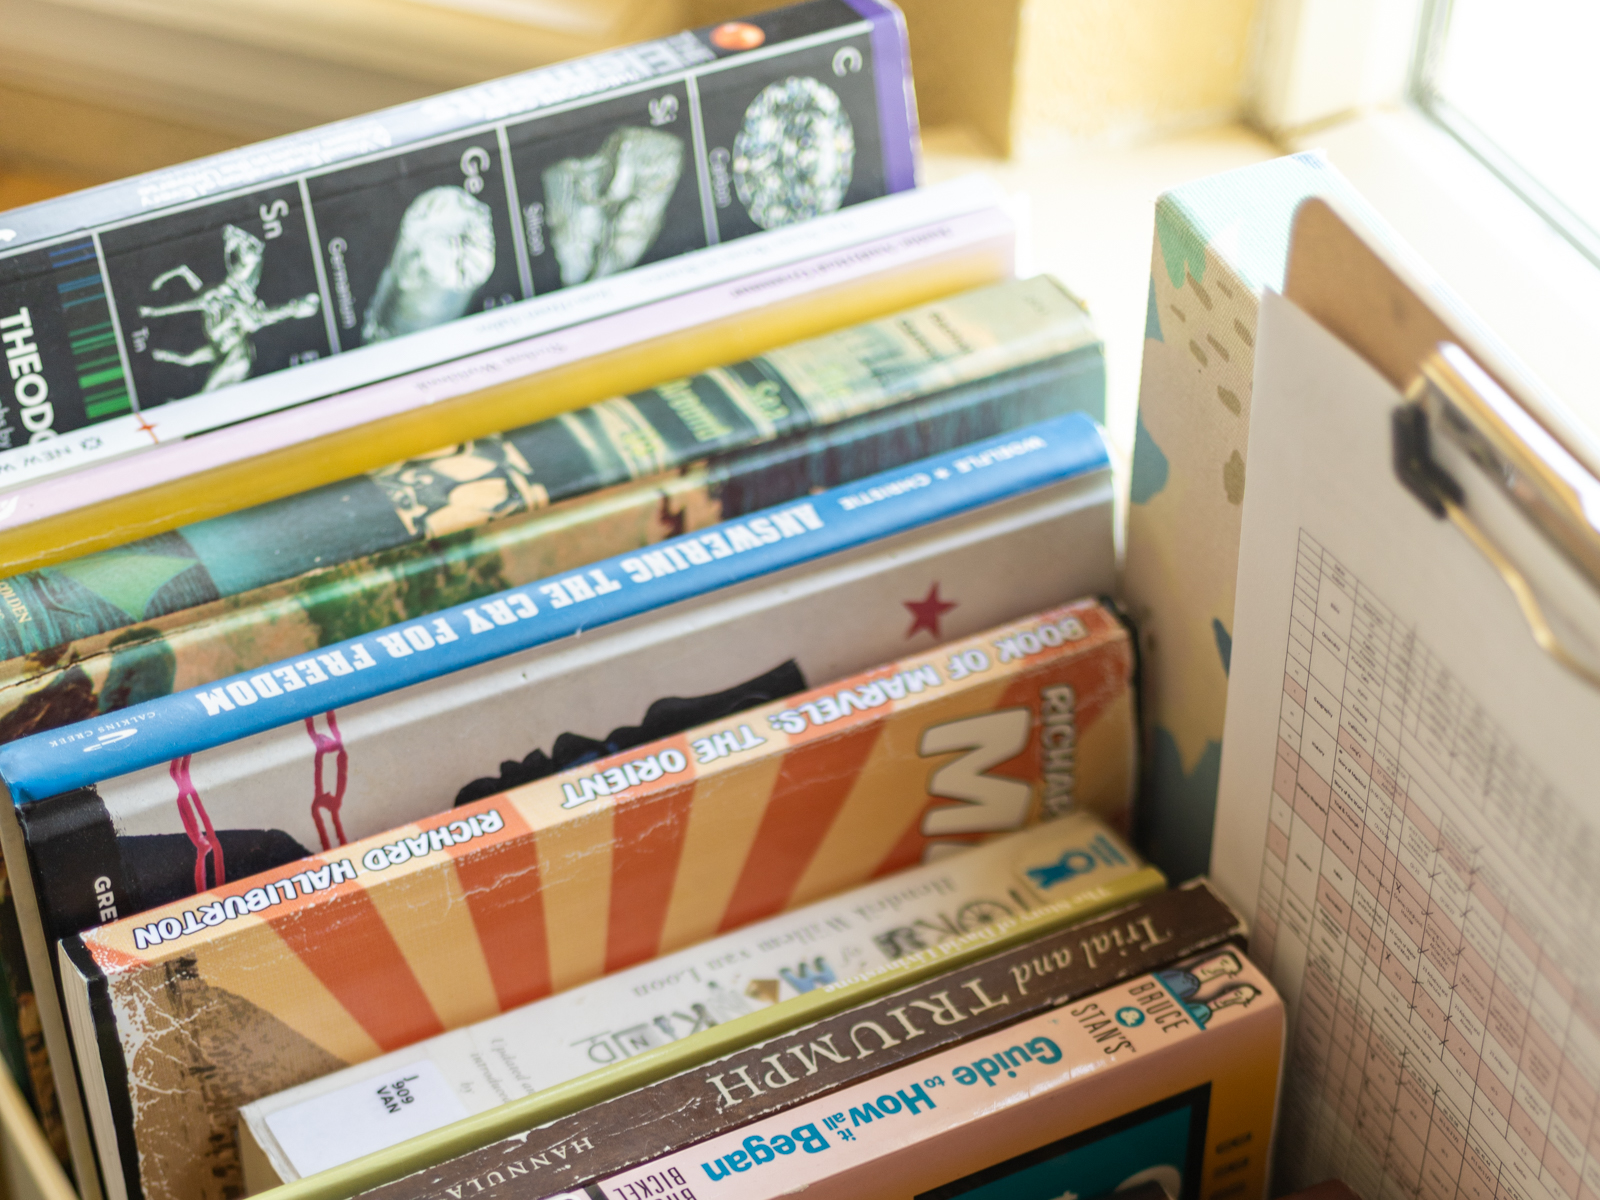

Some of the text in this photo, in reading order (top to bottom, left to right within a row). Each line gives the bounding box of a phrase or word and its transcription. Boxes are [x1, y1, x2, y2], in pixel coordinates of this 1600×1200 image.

[832, 45, 863, 76] C
[460, 146, 490, 194] Ge
[259, 199, 289, 240] Sn
[131, 327, 147, 353] Tin
[840, 473, 932, 511] CHRISTIE
[195, 502, 824, 717] ANSWERING THE CRY FOR FREEDOM
[998, 617, 1088, 663] BOOK
[948, 650, 988, 678] OF
[49, 711, 156, 749] CALKINS CREEK
[694, 724, 767, 763] THE
[560, 748, 687, 808] ORIENT
[93, 875, 119, 922] GRE
[134, 809, 504, 949] RICHARD HALLIBURTON
[629, 965, 701, 1000] Loon
[819, 946, 938, 995] Livingstone
[1128, 982, 1190, 1034] BRUCE
[446, 916, 1173, 1199] Trial and TRIUMPH HANNULA
[951, 1035, 1064, 1087] Guide
[376, 1084, 401, 1114] VAN
[391, 1081, 415, 1105] 909
[924, 1074, 945, 1090] to
[823, 1111, 847, 1131] all
[845, 1081, 938, 1133] How
[701, 1121, 831, 1184] Began
[838, 1129, 856, 1144] it
